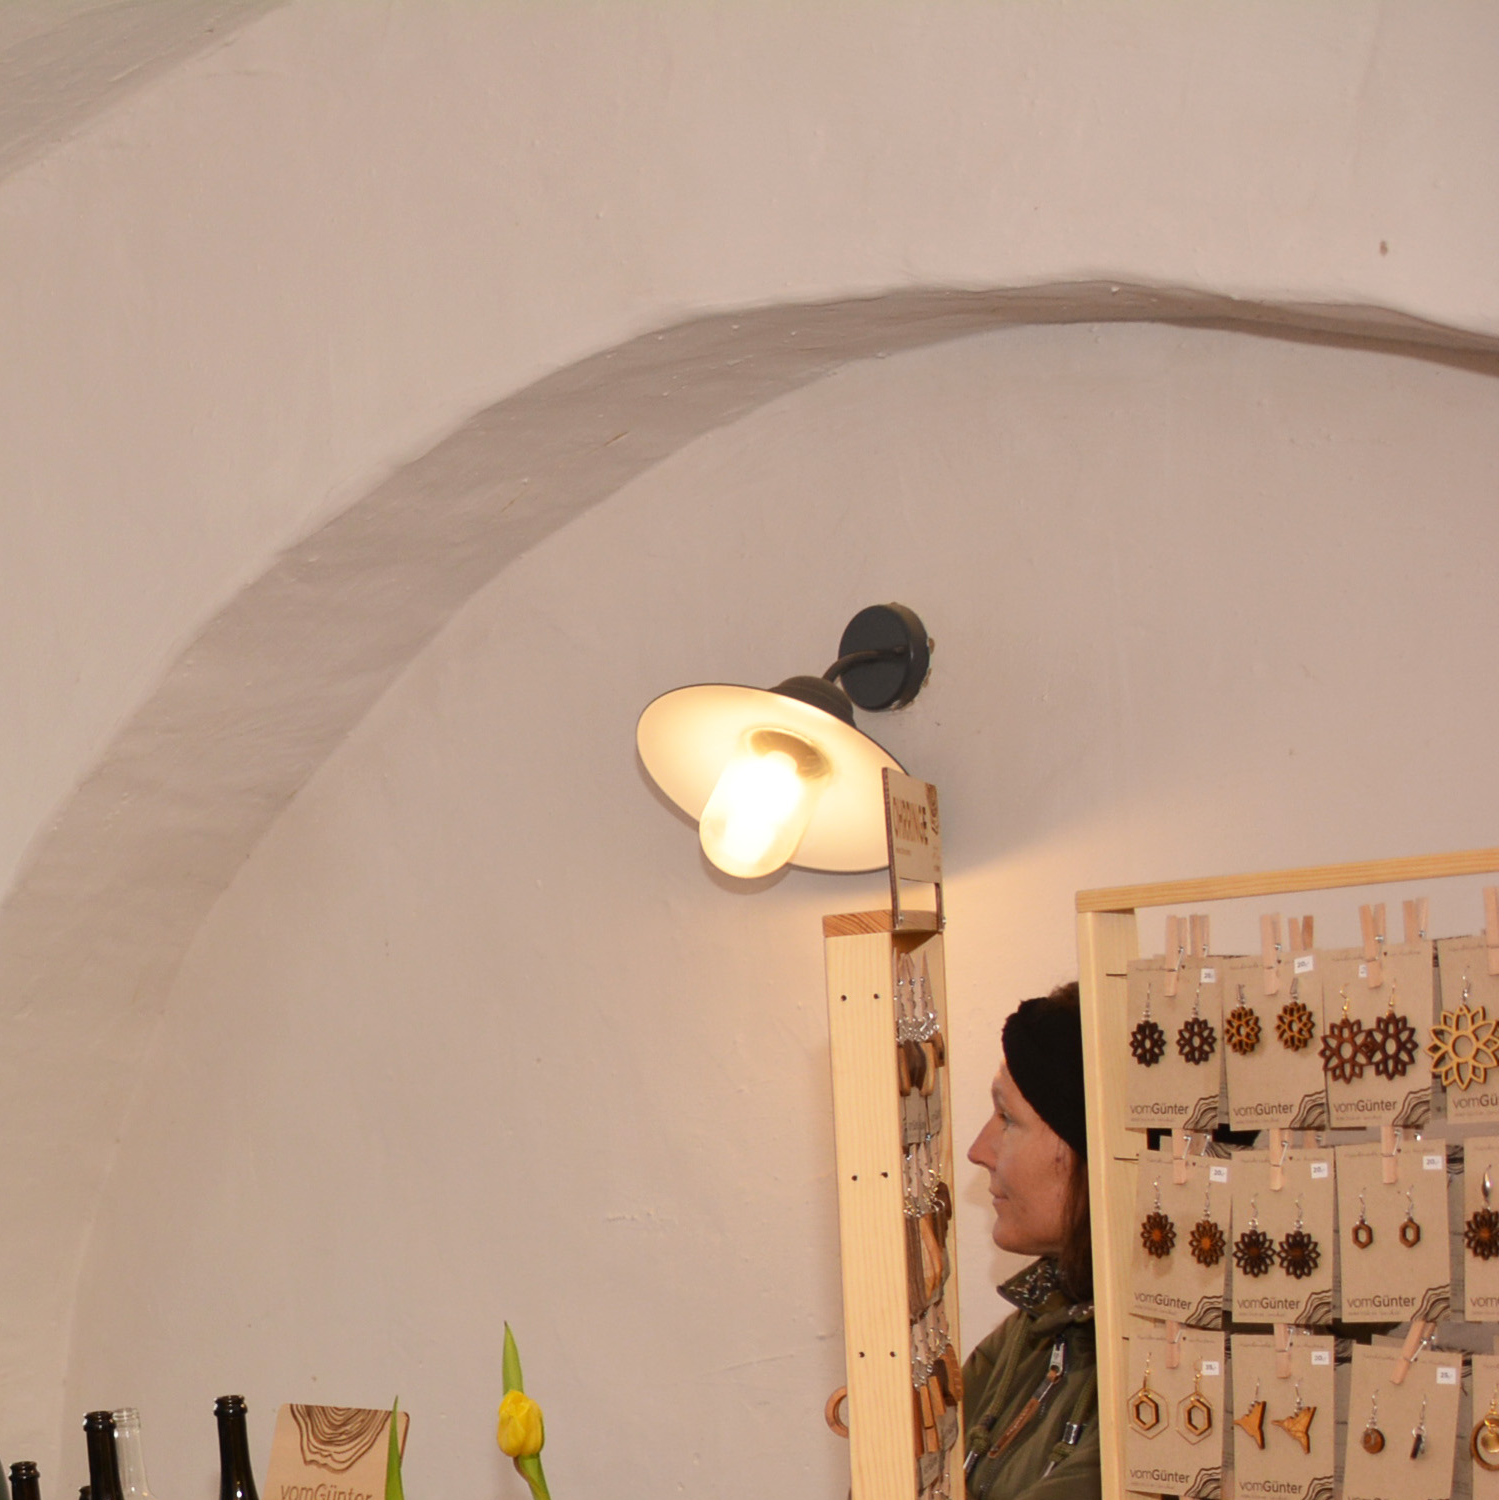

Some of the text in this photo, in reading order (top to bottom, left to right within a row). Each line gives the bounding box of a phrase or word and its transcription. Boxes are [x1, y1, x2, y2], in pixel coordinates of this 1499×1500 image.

[1130, 1102, 1190, 1115] vomGünter
[1233, 1103, 1294, 1116] vomGünter
[1333, 1099, 1398, 1113] vomGünter
[1134, 1291, 1192, 1311] vomGünter
[1237, 1297, 1300, 1310] vomGünter
[1347, 1295, 1417, 1308] vomGünter
[1129, 1467, 1190, 1484] vomGünter
[1239, 1480, 1303, 1495] vomGünter
